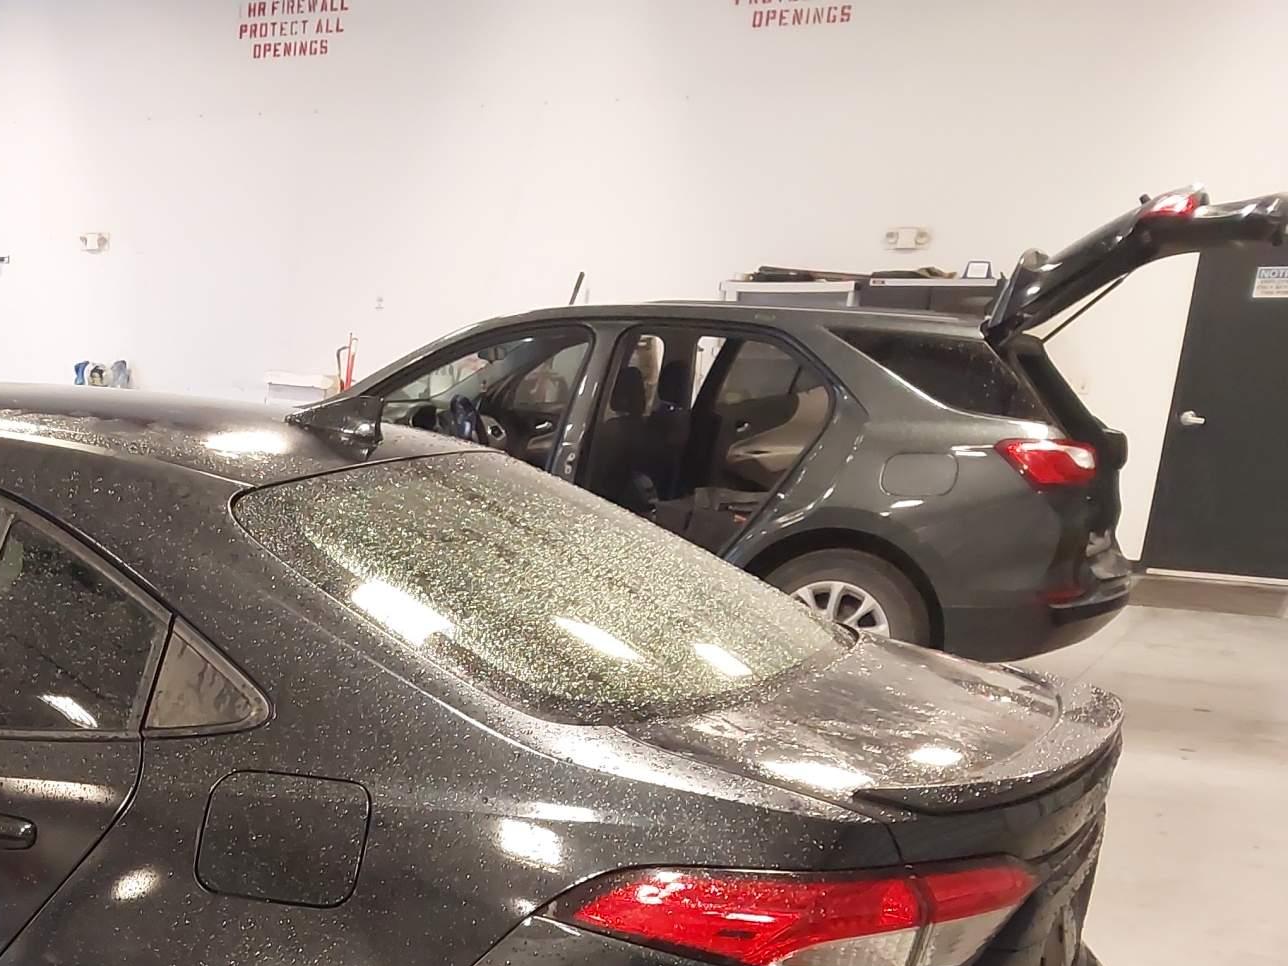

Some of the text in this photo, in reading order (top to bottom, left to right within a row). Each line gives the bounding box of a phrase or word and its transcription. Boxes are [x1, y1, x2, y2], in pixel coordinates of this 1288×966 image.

[247, 1, 267, 18] HR
[271, 0, 349, 16] FIREWALL
[751, 5, 852, 28] OPENINGS
[239, 18, 344, 39] PROTECT ALL
[253, 39, 329, 59] OPENINGS
